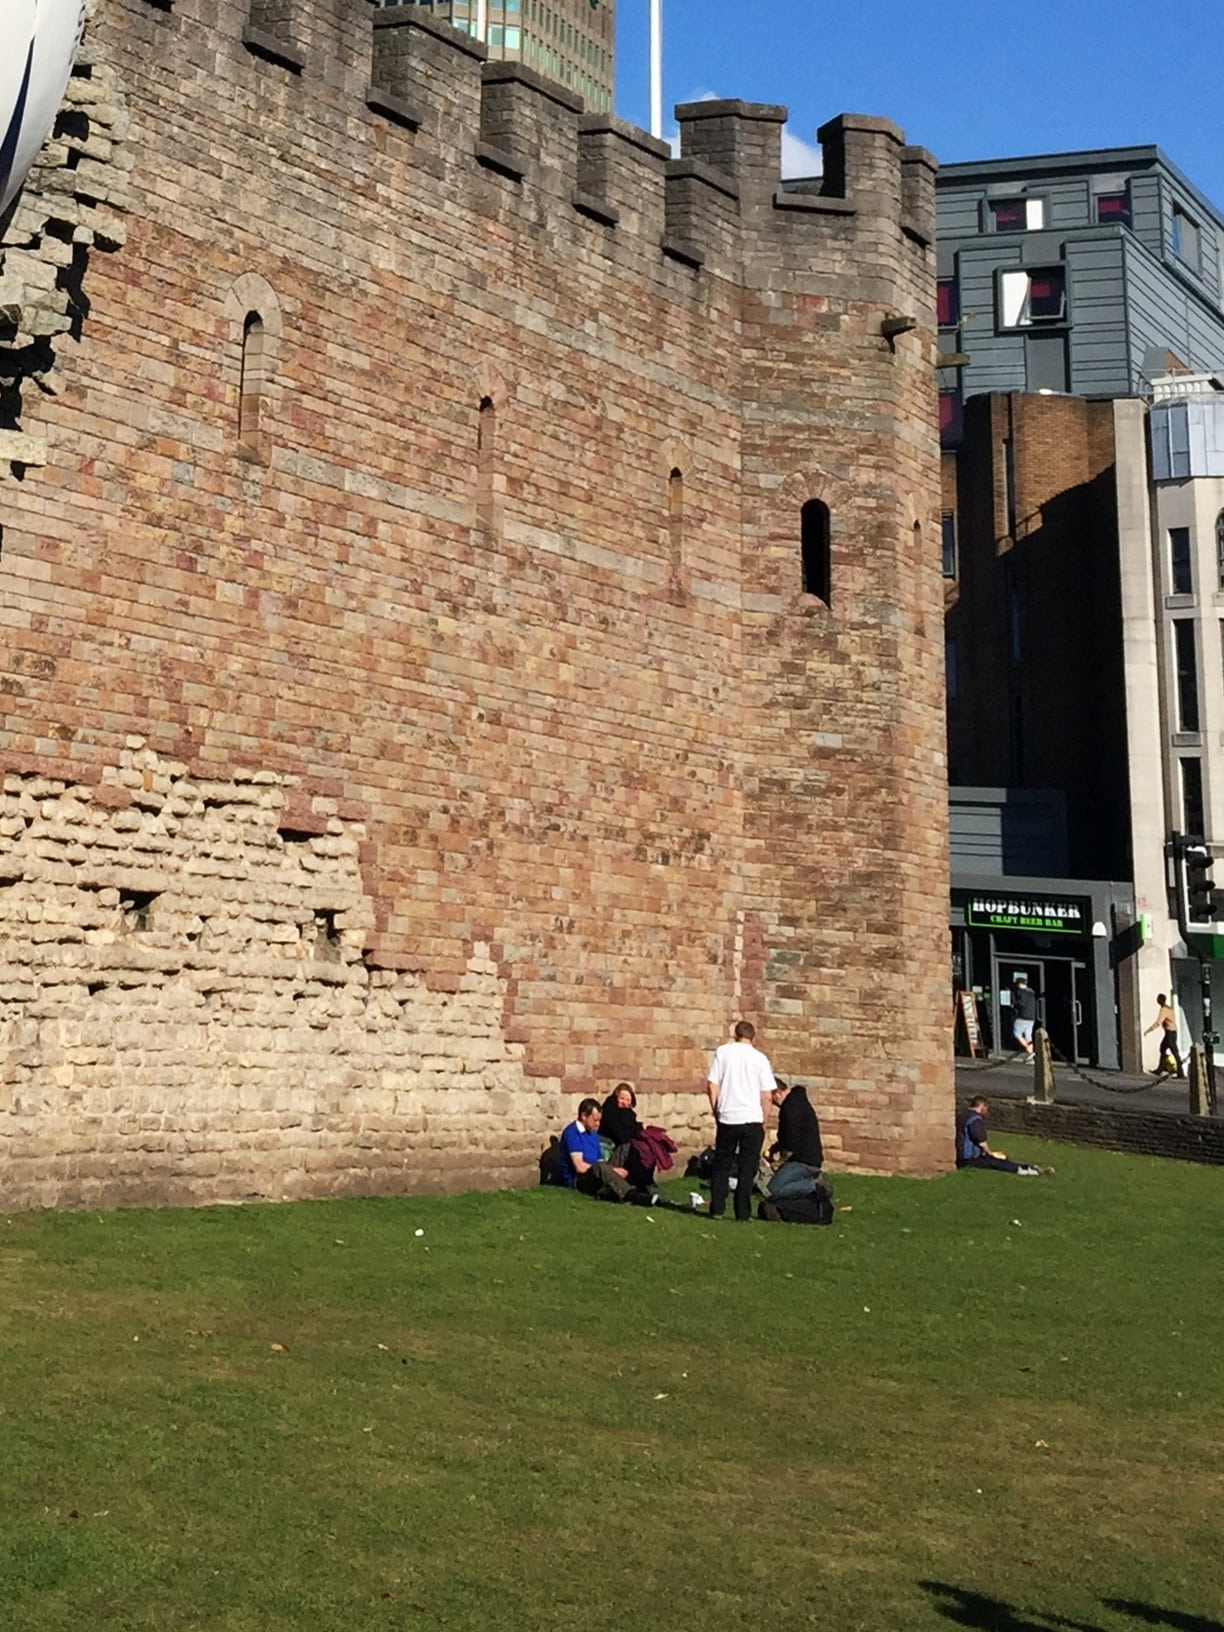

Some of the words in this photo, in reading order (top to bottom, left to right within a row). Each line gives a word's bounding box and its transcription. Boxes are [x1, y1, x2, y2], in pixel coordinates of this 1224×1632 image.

[972, 898, 1081, 918] HOPBUNKER
[990, 915, 1017, 924] CRAFT
[1020, 917, 1043, 926] BEER
[1045, 919, 1063, 927] BAR
